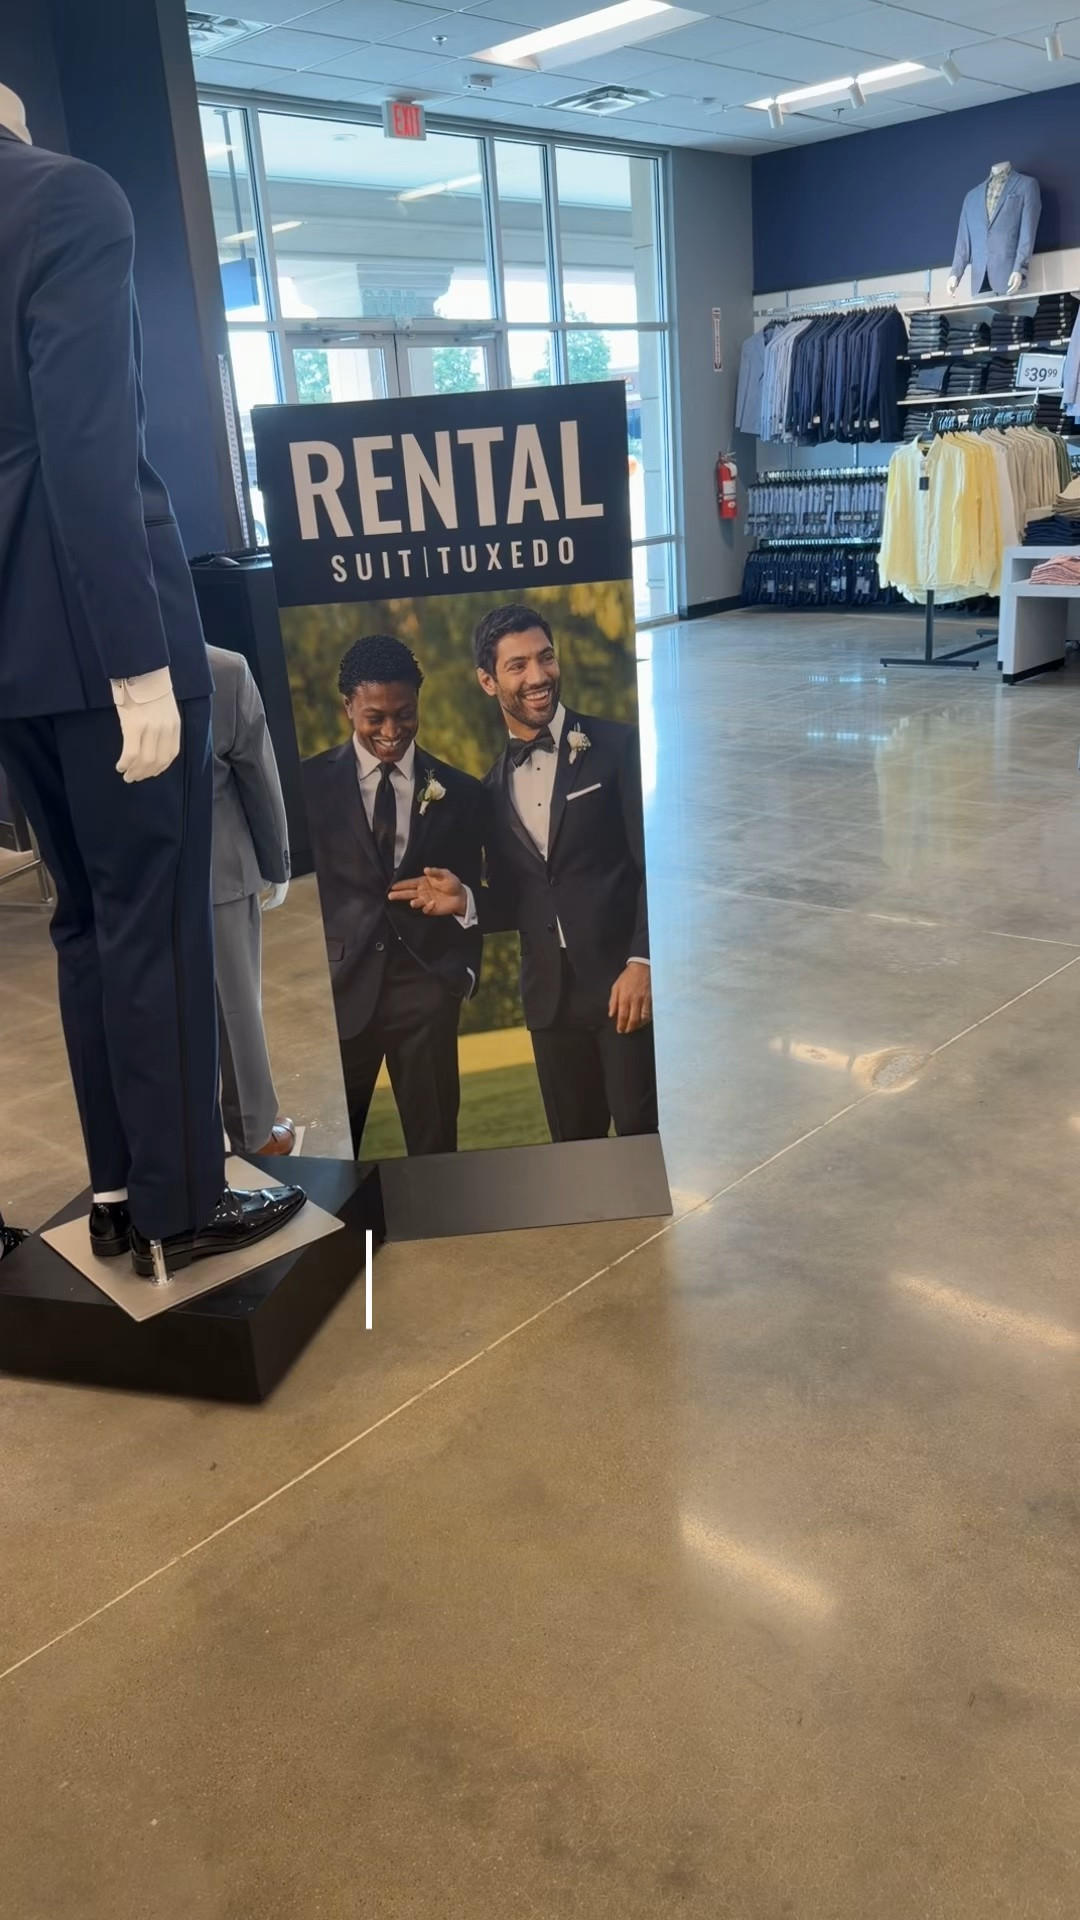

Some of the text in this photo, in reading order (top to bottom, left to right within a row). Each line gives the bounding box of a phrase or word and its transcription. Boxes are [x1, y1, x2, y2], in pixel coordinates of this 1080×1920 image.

[393, 103, 420, 136] EXIT
[289, 420, 604, 540] RENTAL
[331, 536, 574, 582] SUIT TUXEDO
